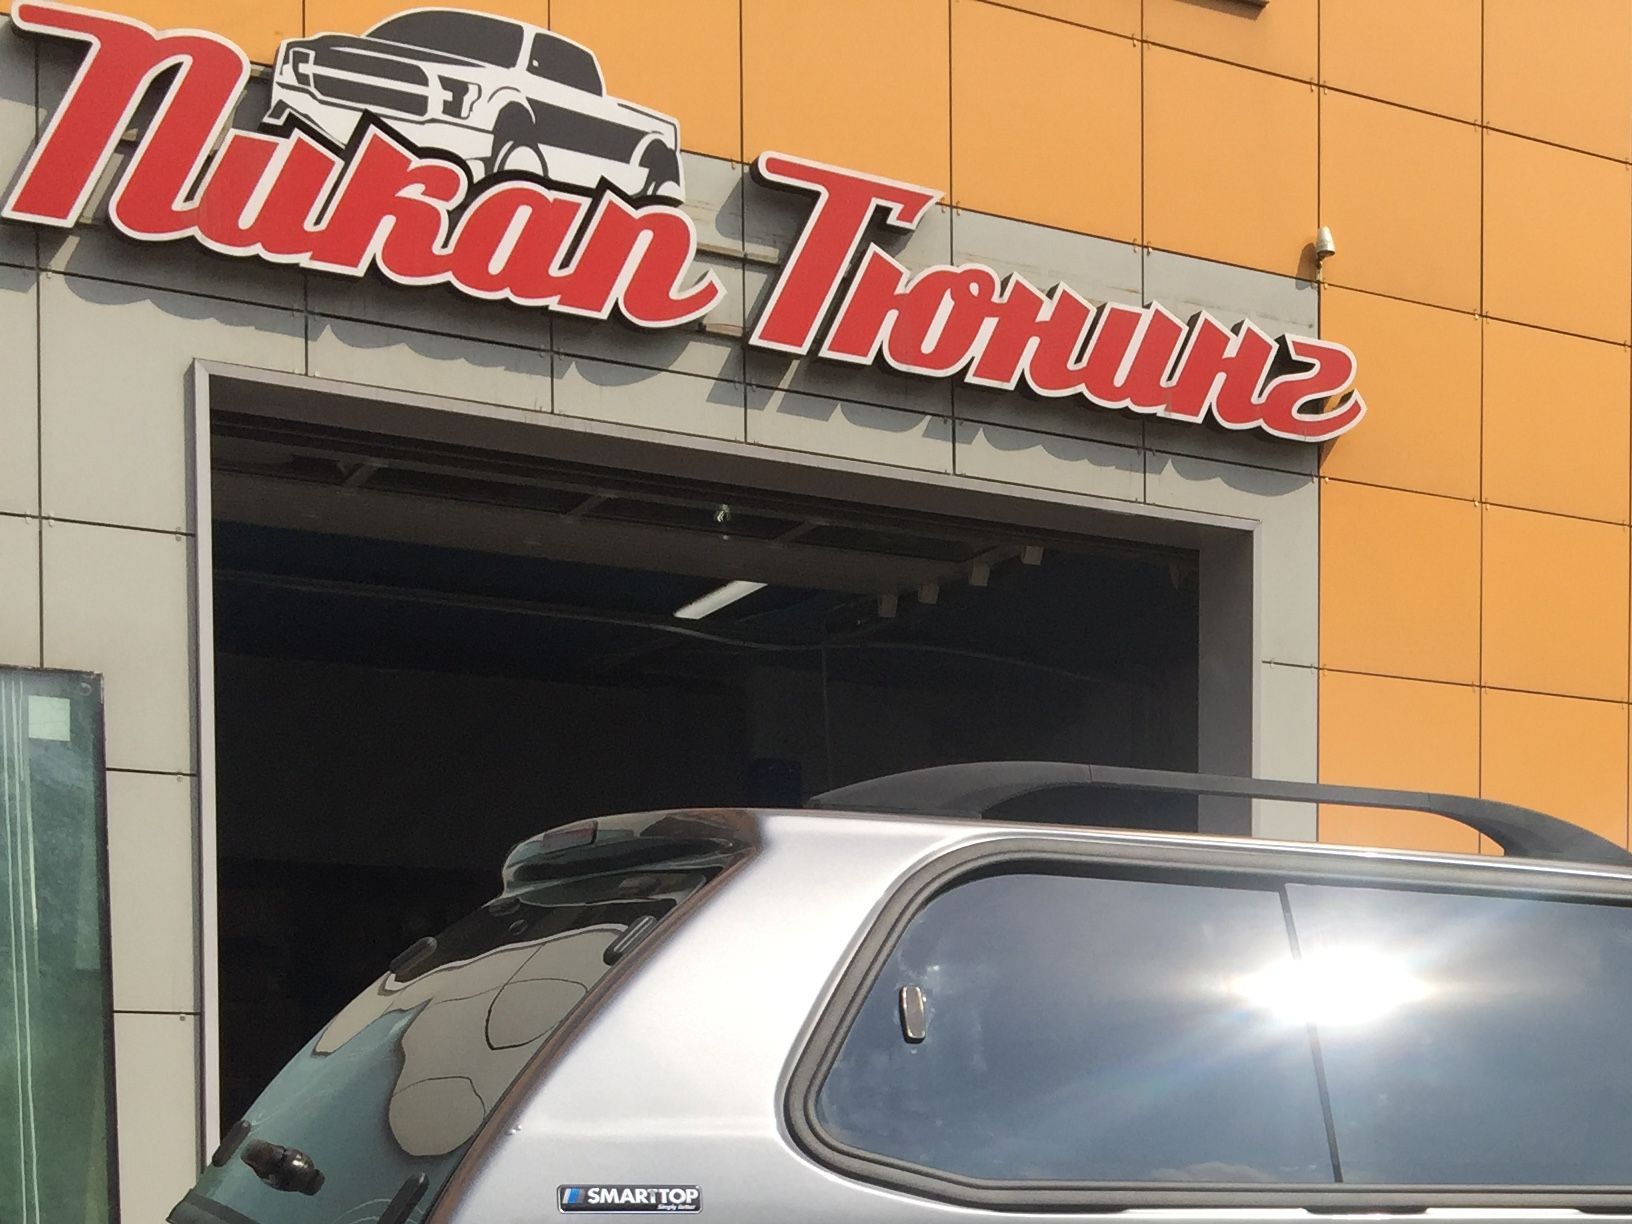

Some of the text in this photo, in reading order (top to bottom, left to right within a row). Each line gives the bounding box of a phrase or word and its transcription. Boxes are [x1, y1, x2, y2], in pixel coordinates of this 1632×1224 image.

[2, 1, 1368, 442] Пикап Тюнинг
[587, 1187, 699, 1204] SMARTTOP
